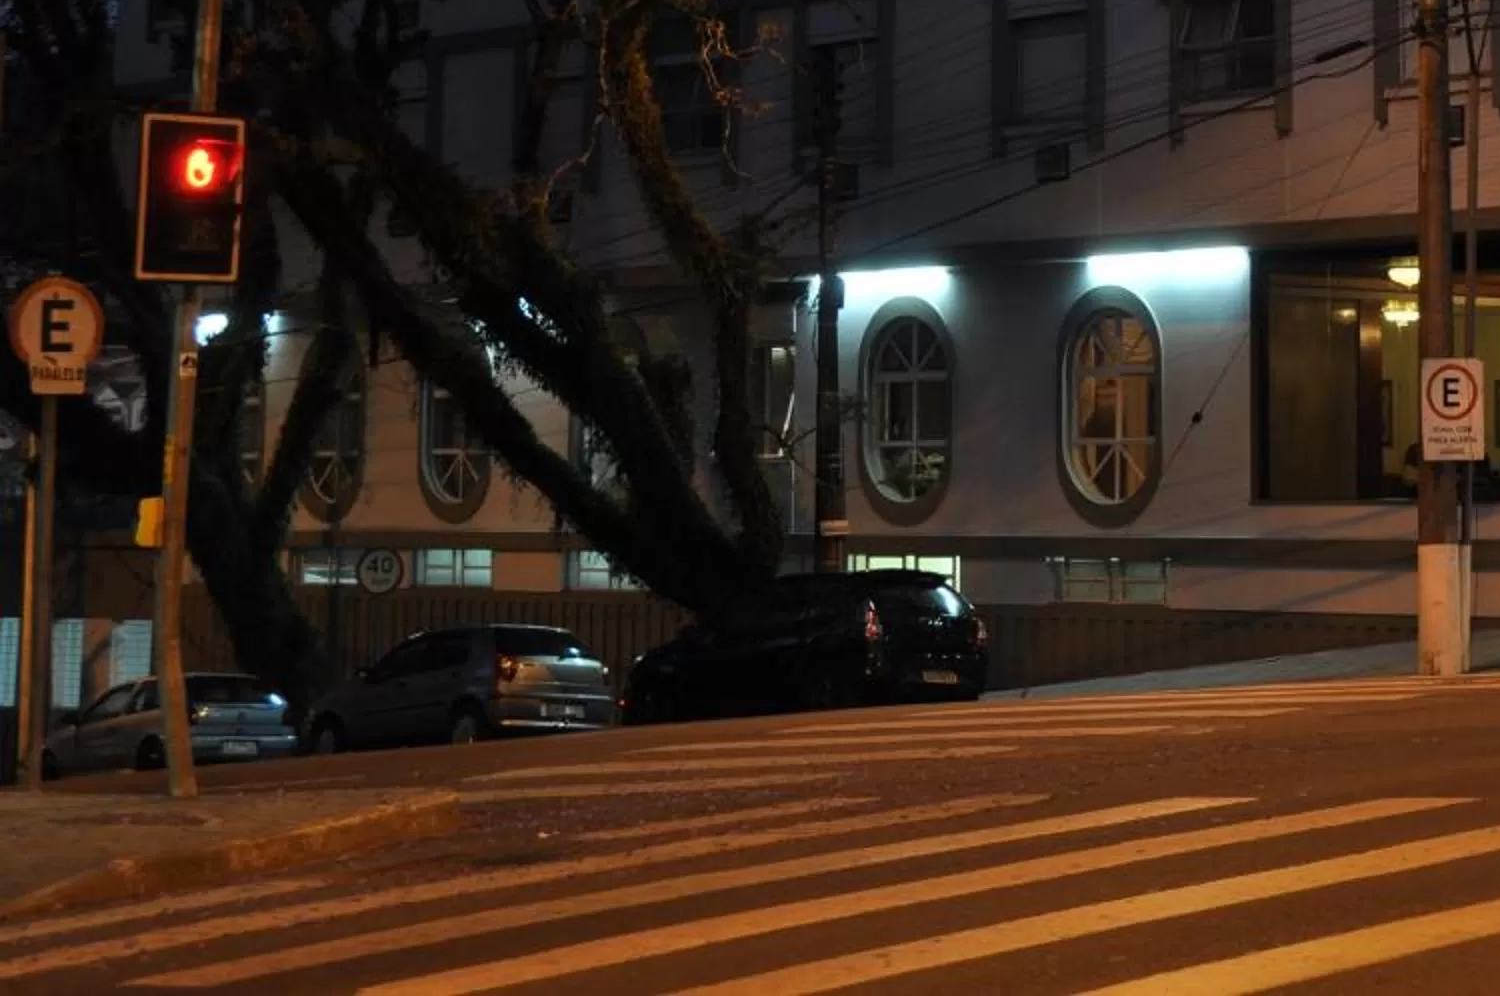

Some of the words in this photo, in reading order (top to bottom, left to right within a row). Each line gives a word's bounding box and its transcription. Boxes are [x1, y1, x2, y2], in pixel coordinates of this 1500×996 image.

[42, 300, 75, 352] E
[1443, 377, 1461, 407] E
[366, 556, 394, 573] 40
